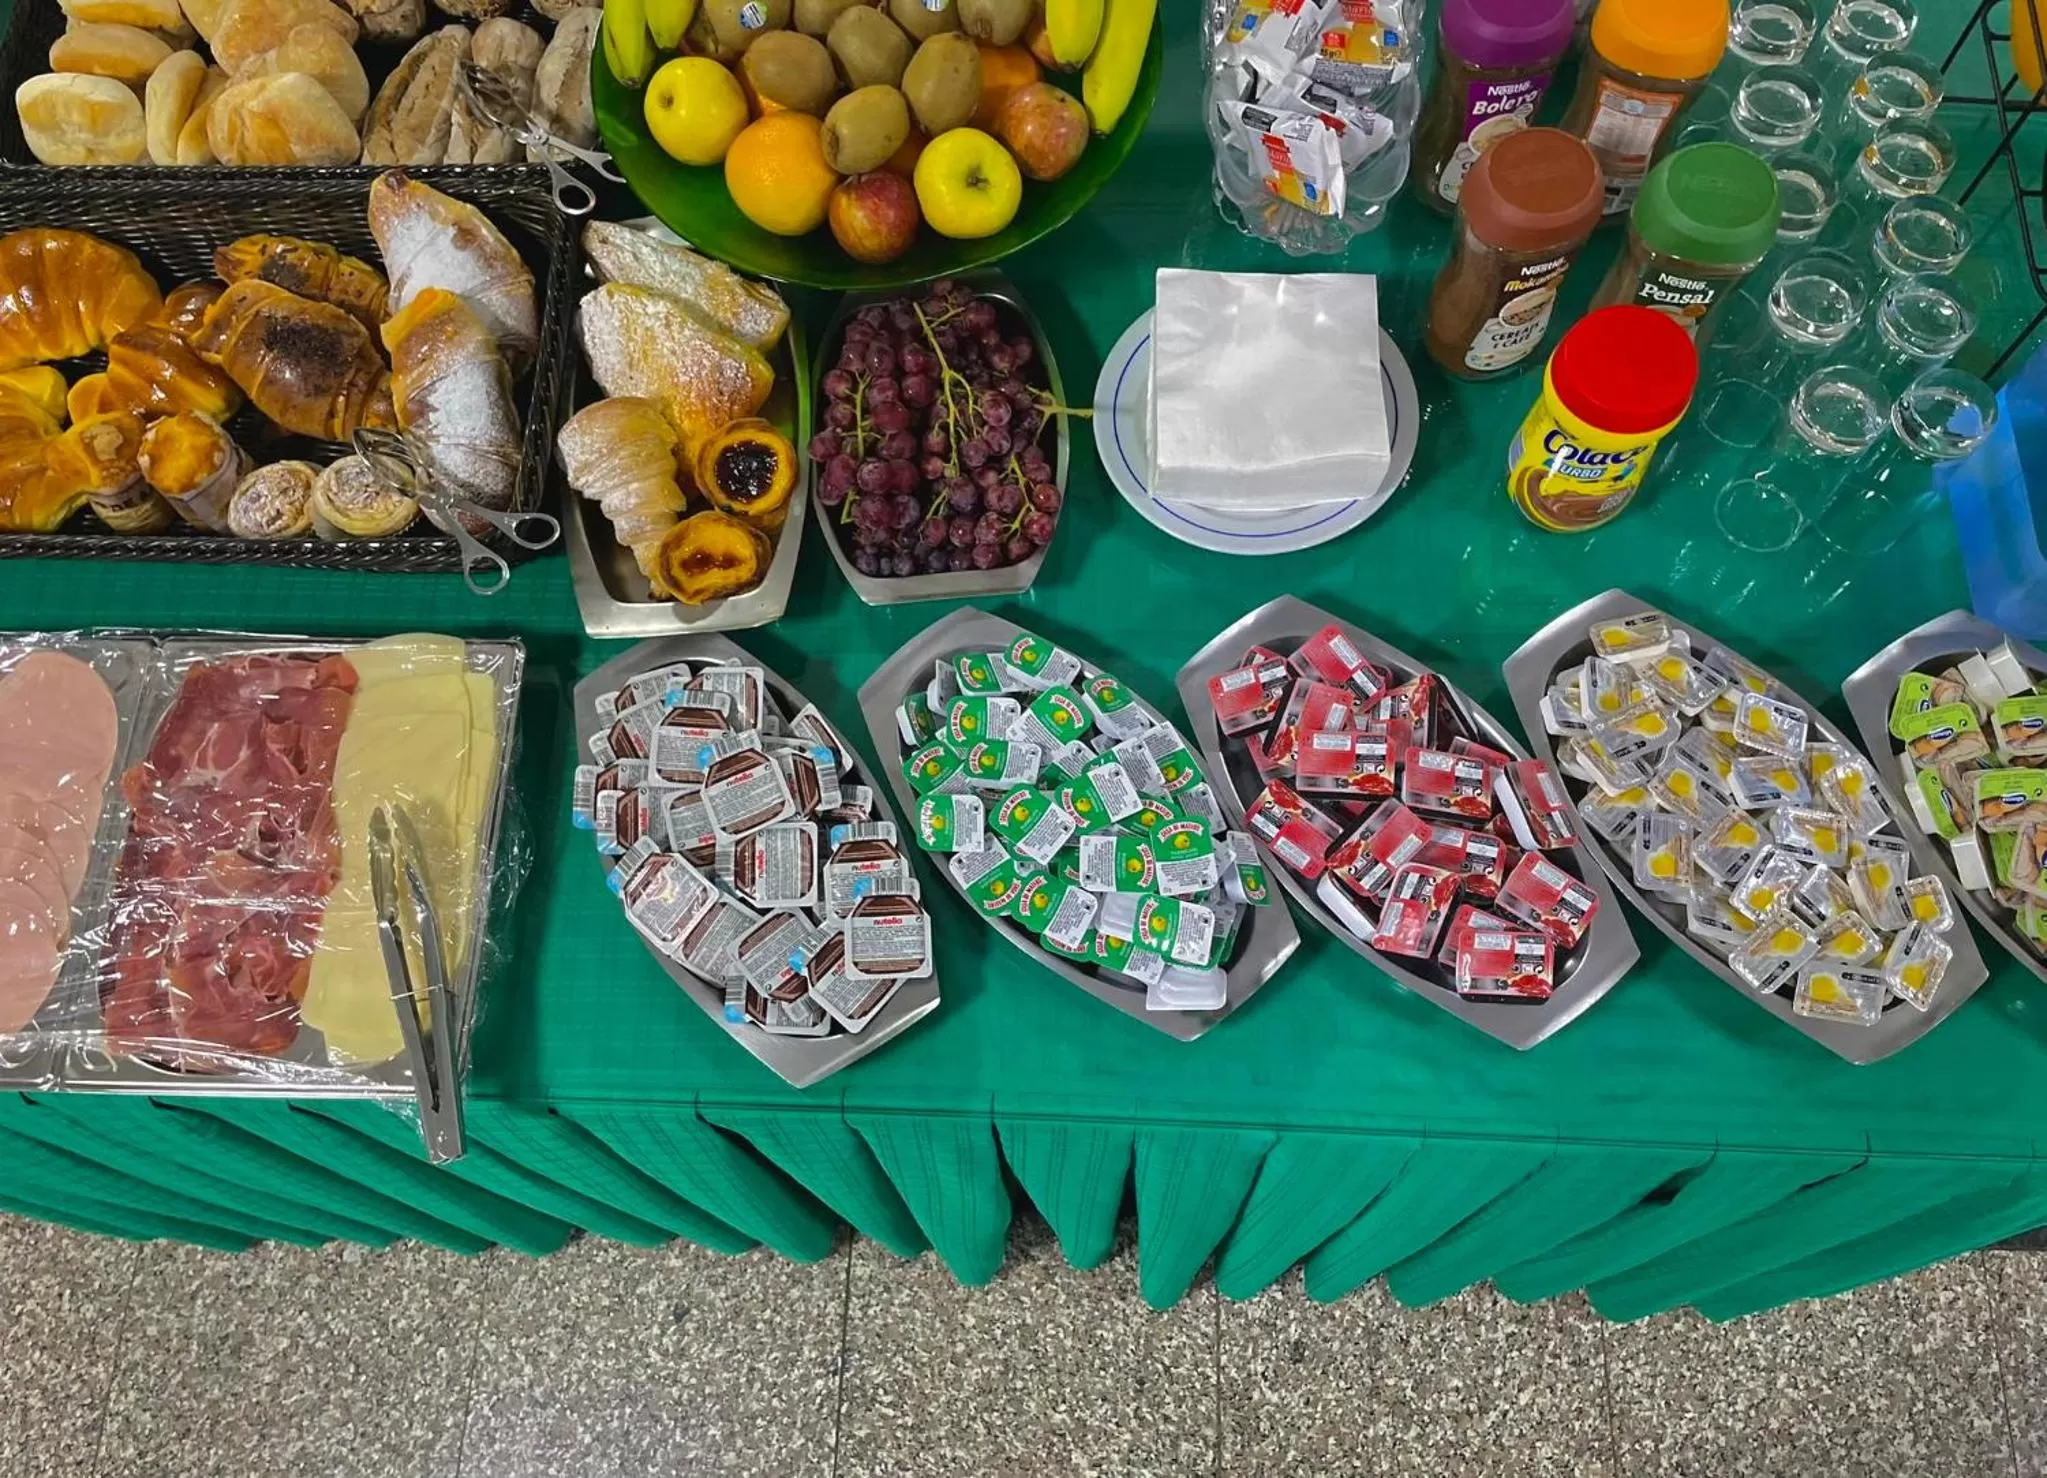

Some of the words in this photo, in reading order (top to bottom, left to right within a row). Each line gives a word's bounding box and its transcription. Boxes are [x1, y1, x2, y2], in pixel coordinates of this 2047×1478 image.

[1472, 91, 1538, 115] Bolero
[1639, 282, 1715, 304] Pensal
[873, 917, 903, 926] nutella
